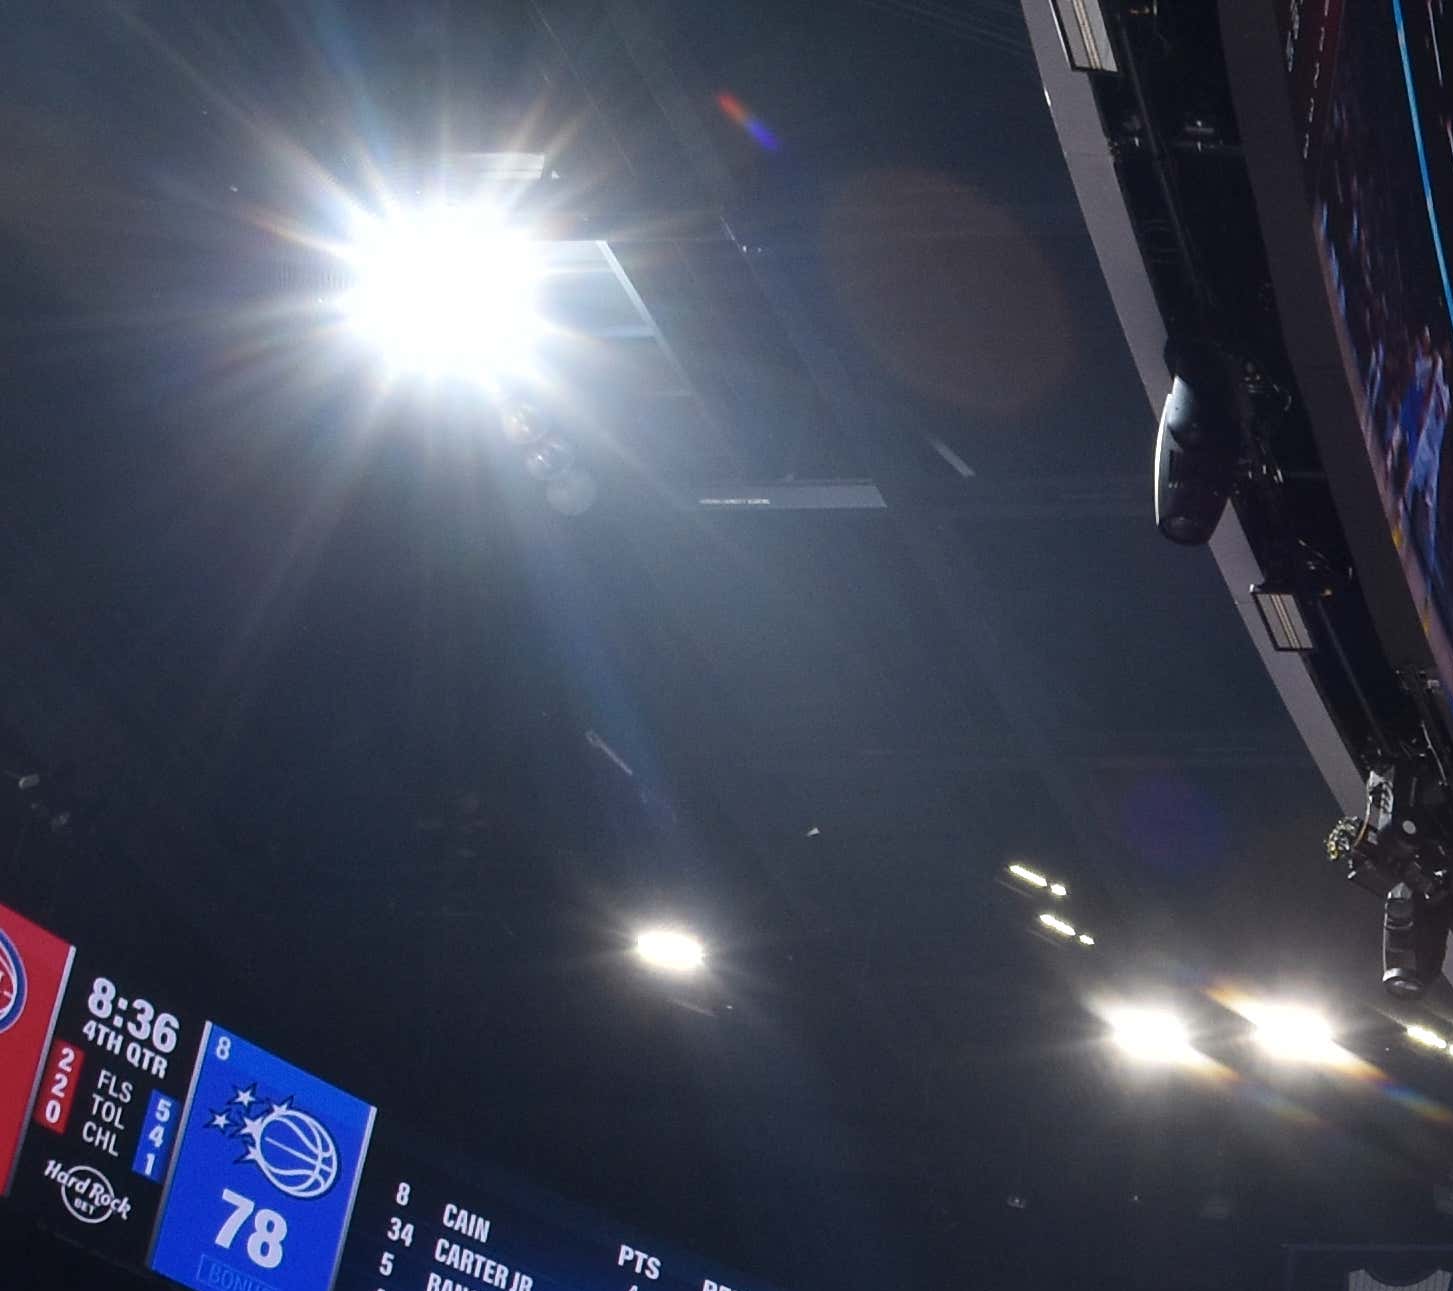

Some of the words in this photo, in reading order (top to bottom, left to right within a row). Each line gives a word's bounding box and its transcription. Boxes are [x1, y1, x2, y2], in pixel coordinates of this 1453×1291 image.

[87, 978, 177, 1053] 8:36
[82, 1020, 122, 1058] 4TH
[126, 1042, 169, 1079] QTR
[97, 1070, 133, 1102] FLS
[90, 1095, 126, 1129] TOL
[81, 1121, 119, 1157] CHL
[44, 1159, 87, 1197] Hard
[85, 1181, 131, 1219] Rock
[212, 1188, 289, 1269] 78
[442, 1203, 490, 1243] CAIN
[617, 1245, 661, 1280] PTS
